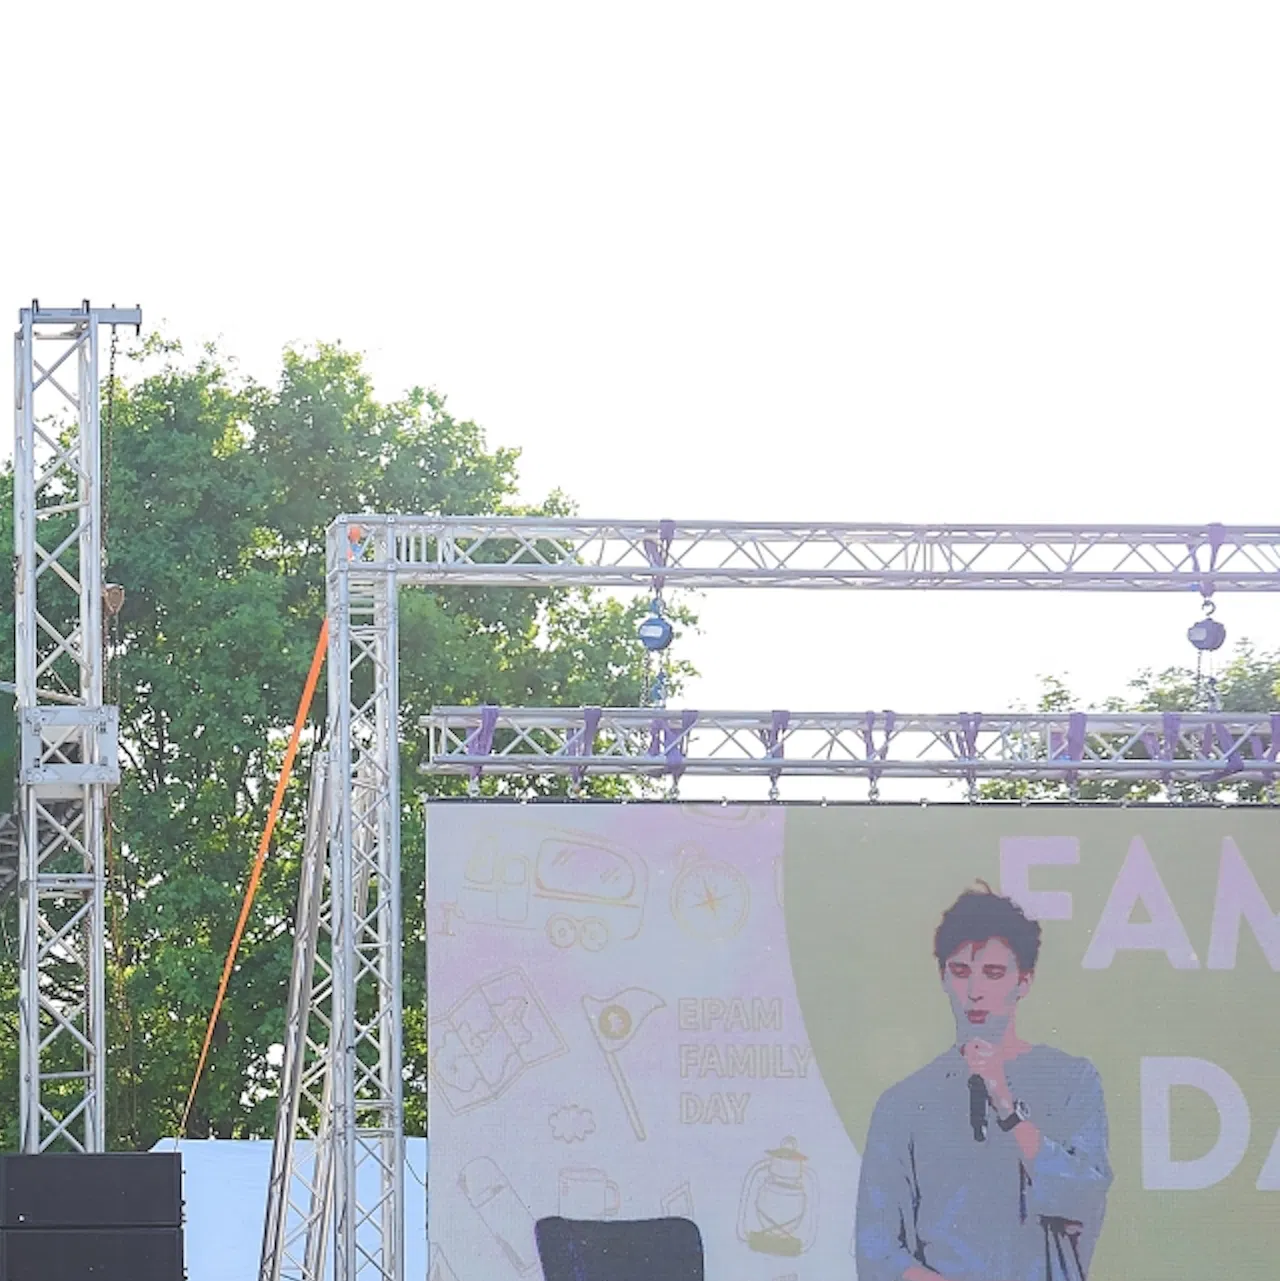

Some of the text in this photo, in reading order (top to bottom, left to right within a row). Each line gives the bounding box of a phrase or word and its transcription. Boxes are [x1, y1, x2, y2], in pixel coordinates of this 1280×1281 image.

[678, 997, 784, 1031] EPAM
[680, 1044, 814, 1079] FAMILY
[680, 1092, 751, 1124] DAY
[1141, 1056, 1280, 1191] D
